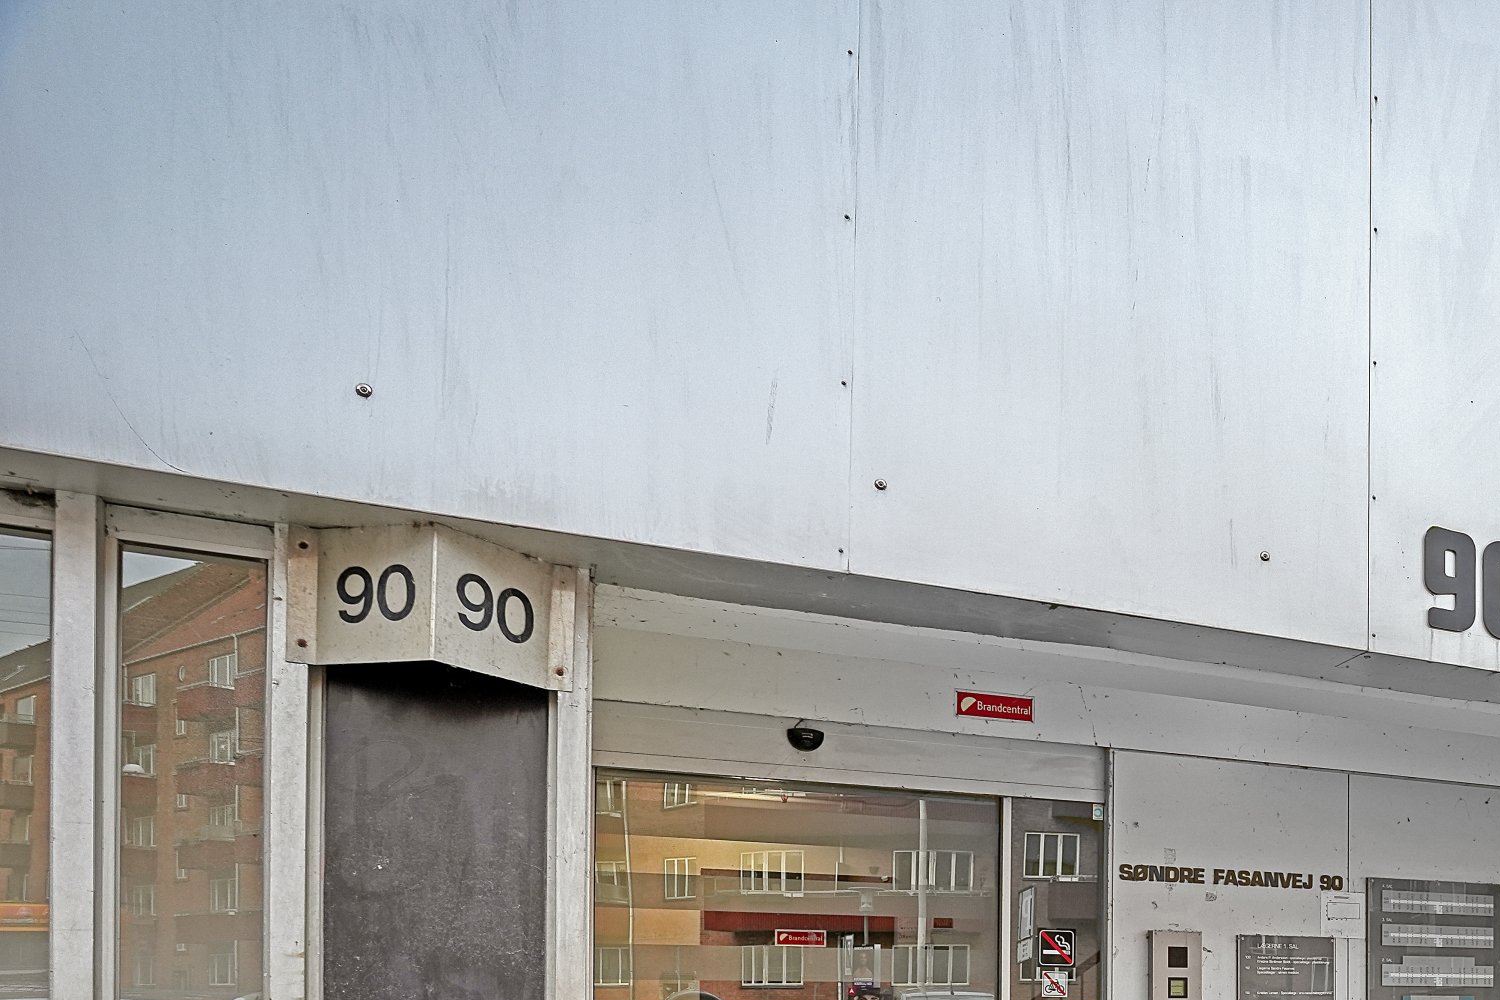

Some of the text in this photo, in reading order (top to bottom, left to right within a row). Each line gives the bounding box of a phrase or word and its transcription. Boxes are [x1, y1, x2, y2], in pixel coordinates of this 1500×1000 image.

[336, 563, 417, 624] 90
[455, 572, 535, 644] 90
[976, 701, 1031, 716] Brandcentral
[1119, 864, 1344, 891] SØNDRE FASANVEJ 90
